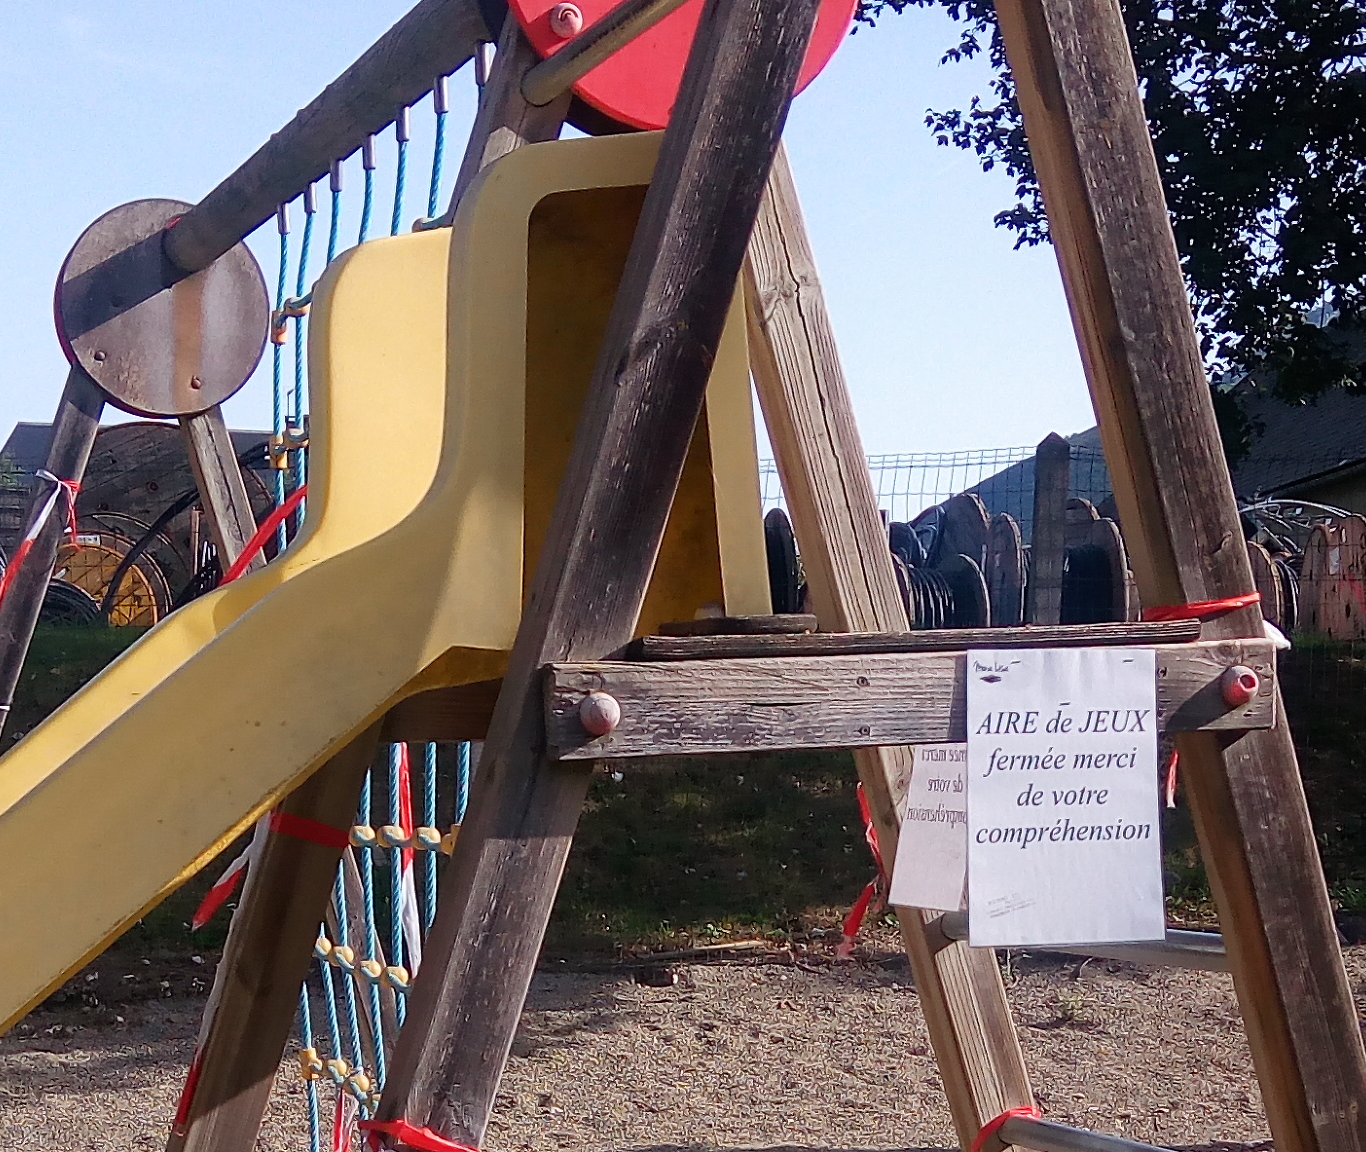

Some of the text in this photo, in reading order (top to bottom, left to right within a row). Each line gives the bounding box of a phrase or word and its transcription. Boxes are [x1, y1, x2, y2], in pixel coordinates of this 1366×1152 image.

[976, 709, 1150, 735] AIRE de JEUX
[983, 746, 1137, 778] fermée merci
[1017, 783, 1109, 806] de votre
[975, 818, 1151, 850] compréhension
